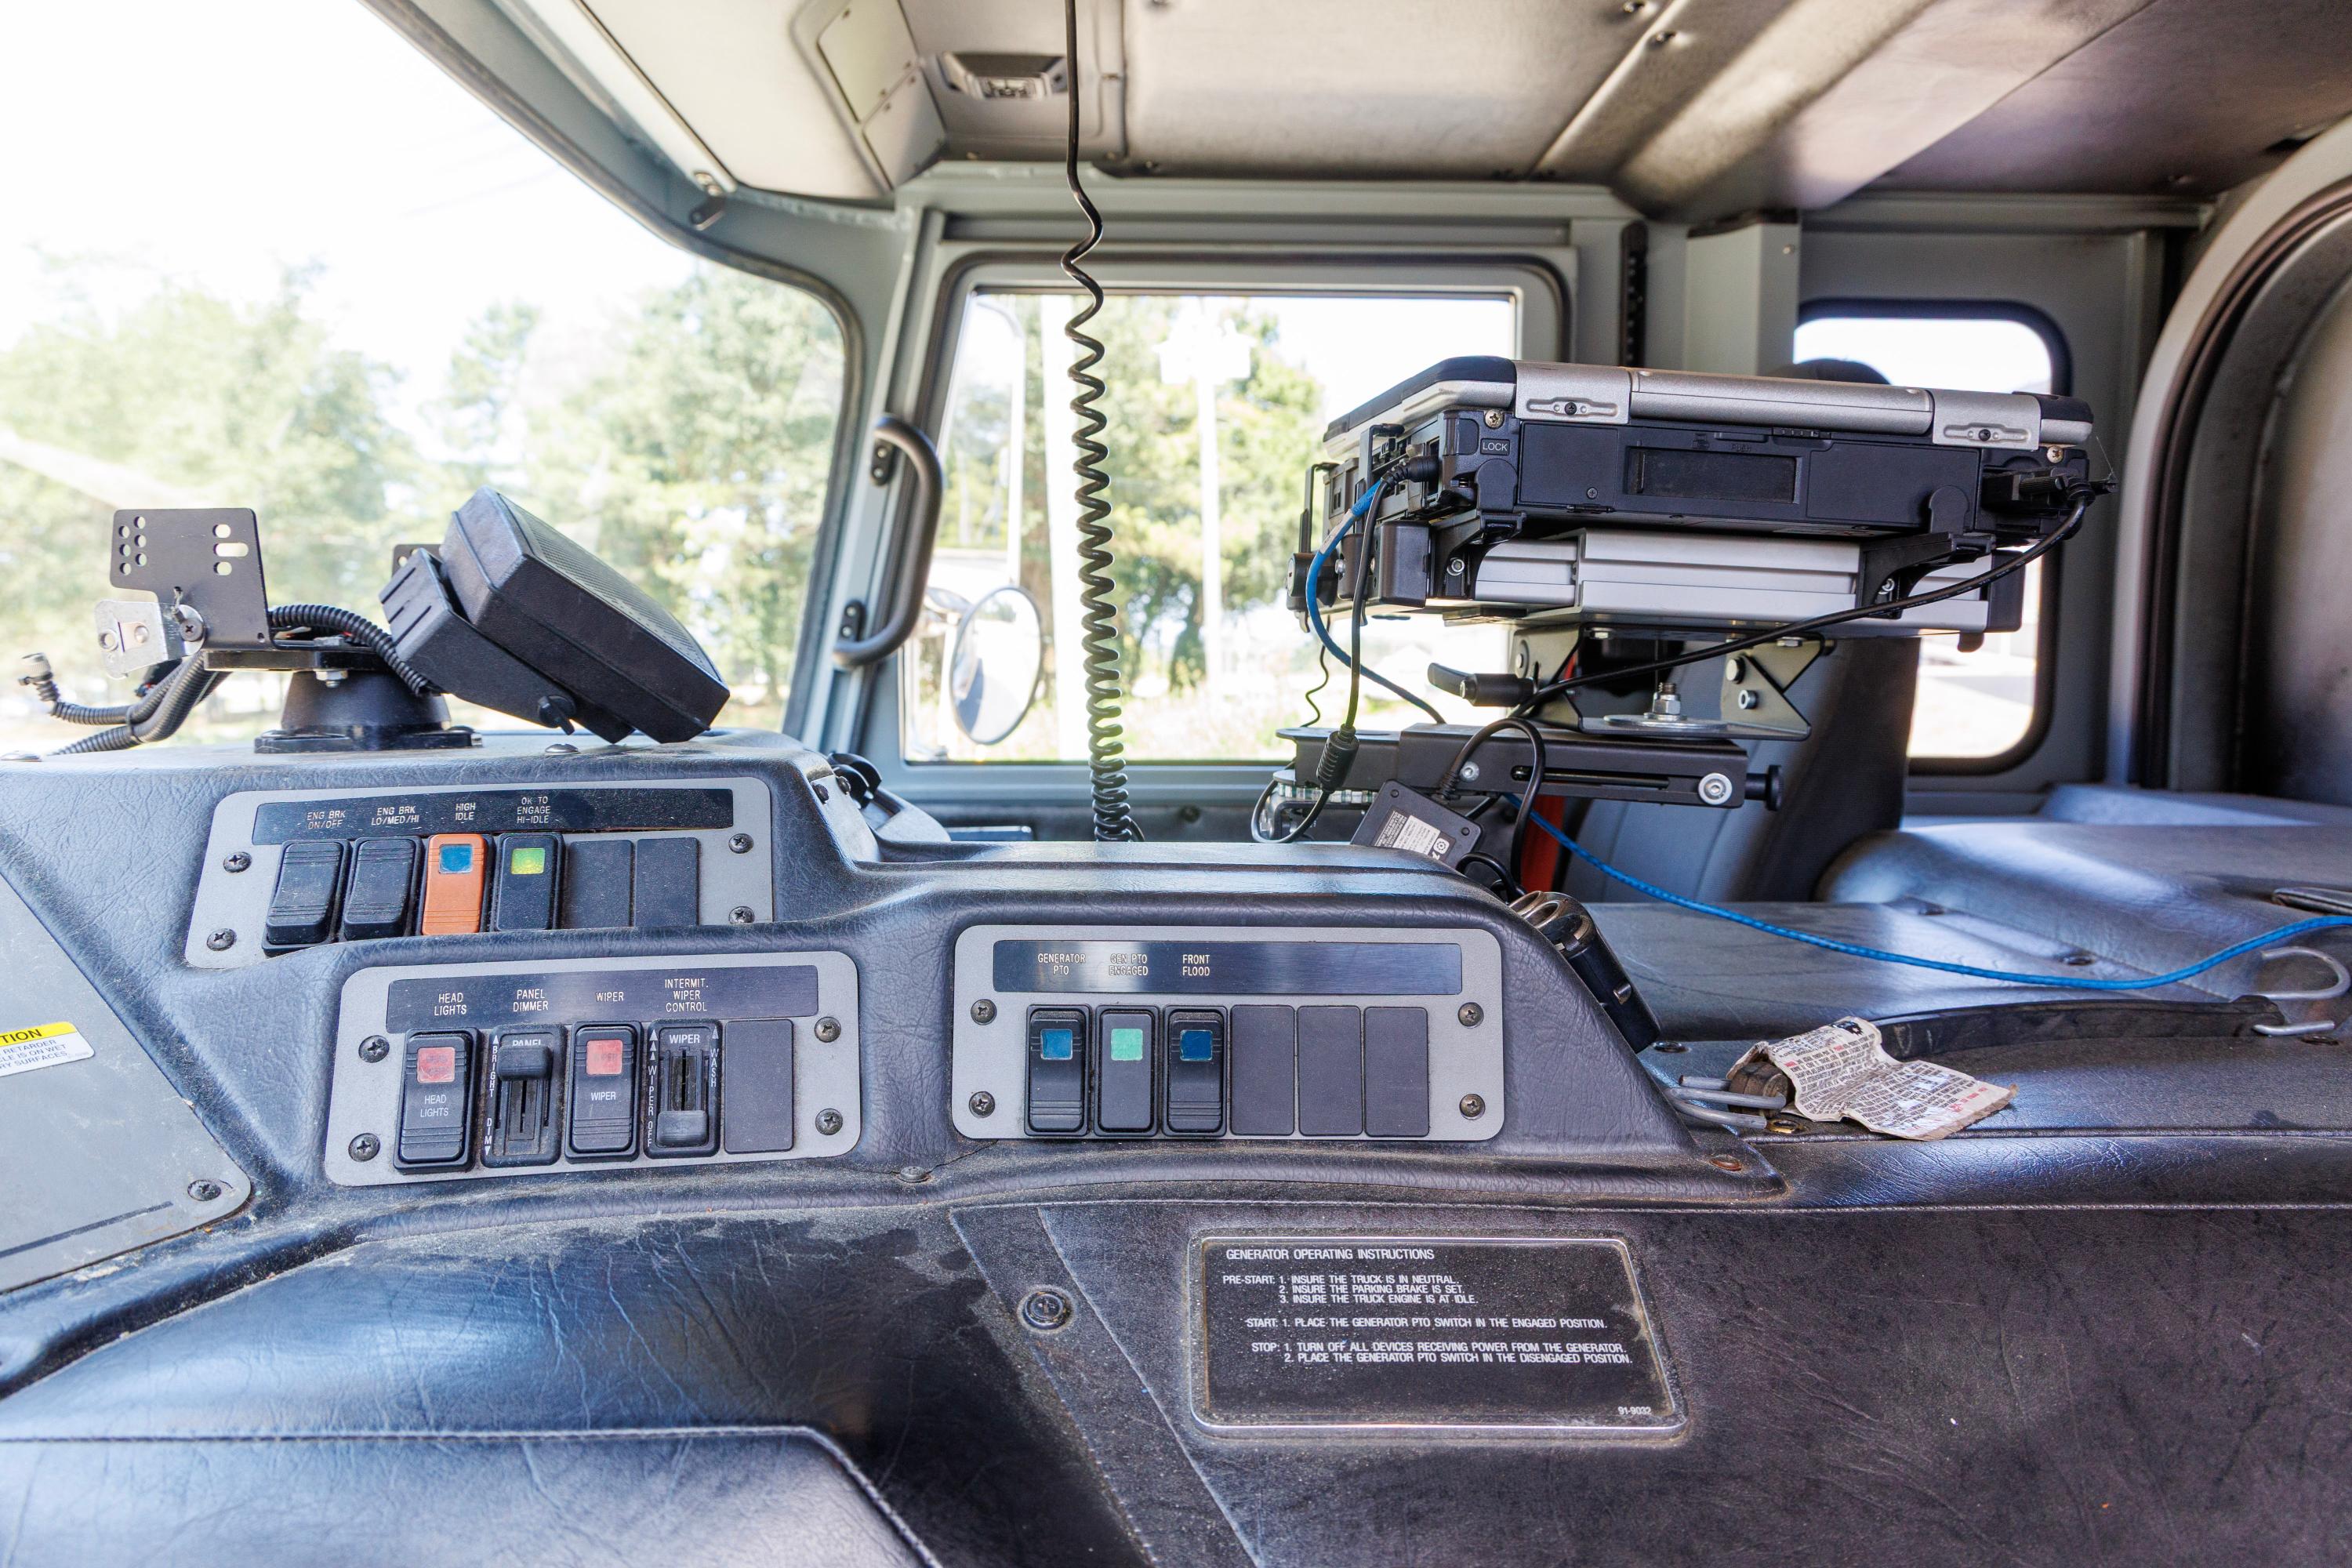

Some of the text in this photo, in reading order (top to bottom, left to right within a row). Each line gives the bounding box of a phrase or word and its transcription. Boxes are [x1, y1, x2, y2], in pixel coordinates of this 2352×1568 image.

[377, 807, 394, 815] ENG
[456, 803, 476, 811] HIGH
[517, 806, 550, 815] ENGAGE
[328, 810, 346, 818] BRK
[456, 812, 474, 821] IDLE
[308, 820, 342, 829] ON/OFF
[372, 815, 419, 825] LO/MED/HI
[1038, 953, 1086, 963] GENERATOR
[1110, 953, 1147, 964] GEN PTO
[1182, 955, 1210, 964] FRONT
[1054, 966, 1069, 975] PTO
[1109, 966, 1149, 976] ENGAGED
[1182, 967, 1210, 976] FLOOD
[665, 978, 709, 988] INTERMIT.
[439, 993, 463, 1004] HEAD
[517, 989, 545, 1000] PANEL
[596, 992, 624, 1002] WIPER
[673, 990, 700, 1000] WIPER
[434, 1005, 466, 1016] LIGHTS
[514, 1000, 548, 1012] DIMMER
[666, 1002, 707, 1012] CONTROL
[670, 1034, 700, 1044] WIPER
[3, 1040, 56, 1054] RETARDER
[45, 1044, 67, 1053] WET
[489, 1046, 498, 1097] BRIGHT
[710, 1048, 719, 1087] WASH
[591, 1091, 616, 1100] WIPER
[648, 1065, 658, 1116] WIPER
[425, 1094, 446, 1105] HEAD
[420, 1108, 448, 1117] LIGHTS
[1226, 1249, 1434, 1260] GENERATOR OPERATING INSTRUCTIONS
[1223, 1276, 1459, 1284] PRE-START: 1. INSURE THE TRUCK IS IN NEUTRAL.
[1330, 1285, 1348, 1294] THE
[1352, 1285, 1392, 1294] PARKING
[1397, 1285, 1428, 1294] BRAKE
[1432, 1285, 1441, 1294] IS
[1445, 1285, 1465, 1294] SET.
[1280, 1294, 1478, 1304] 3. INSURE THE TRUCK ENGINE IS AT IDLE.
[1247, 1318, 1607, 1328] START: 1. PLACE THE GENERATOR PTO SWITCH IN THE ENGAGED POSITION.
[1252, 1342, 1626, 1352] STOP: 1. TURN OFF ALL DEVICES RECEIVING POWER FROM THE GENERATOR.
[1284, 1353, 1294, 1362] 2.
[1298, 1353, 1329, 1362] PLACE
[1333, 1353, 1352, 1362] THE
[1356, 1353, 1414, 1362] GENERATOR
[1418, 1353, 1436, 1362] PTO
[1483, 1354, 1493, 1363] IN
[1497, 1354, 1515, 1363] THE
[1520, 1354, 1580, 1363] DISENGAGED
[1584, 1355, 1632, 1363] POSITION.
[1618, 1406, 1651, 1415] 91-9032
